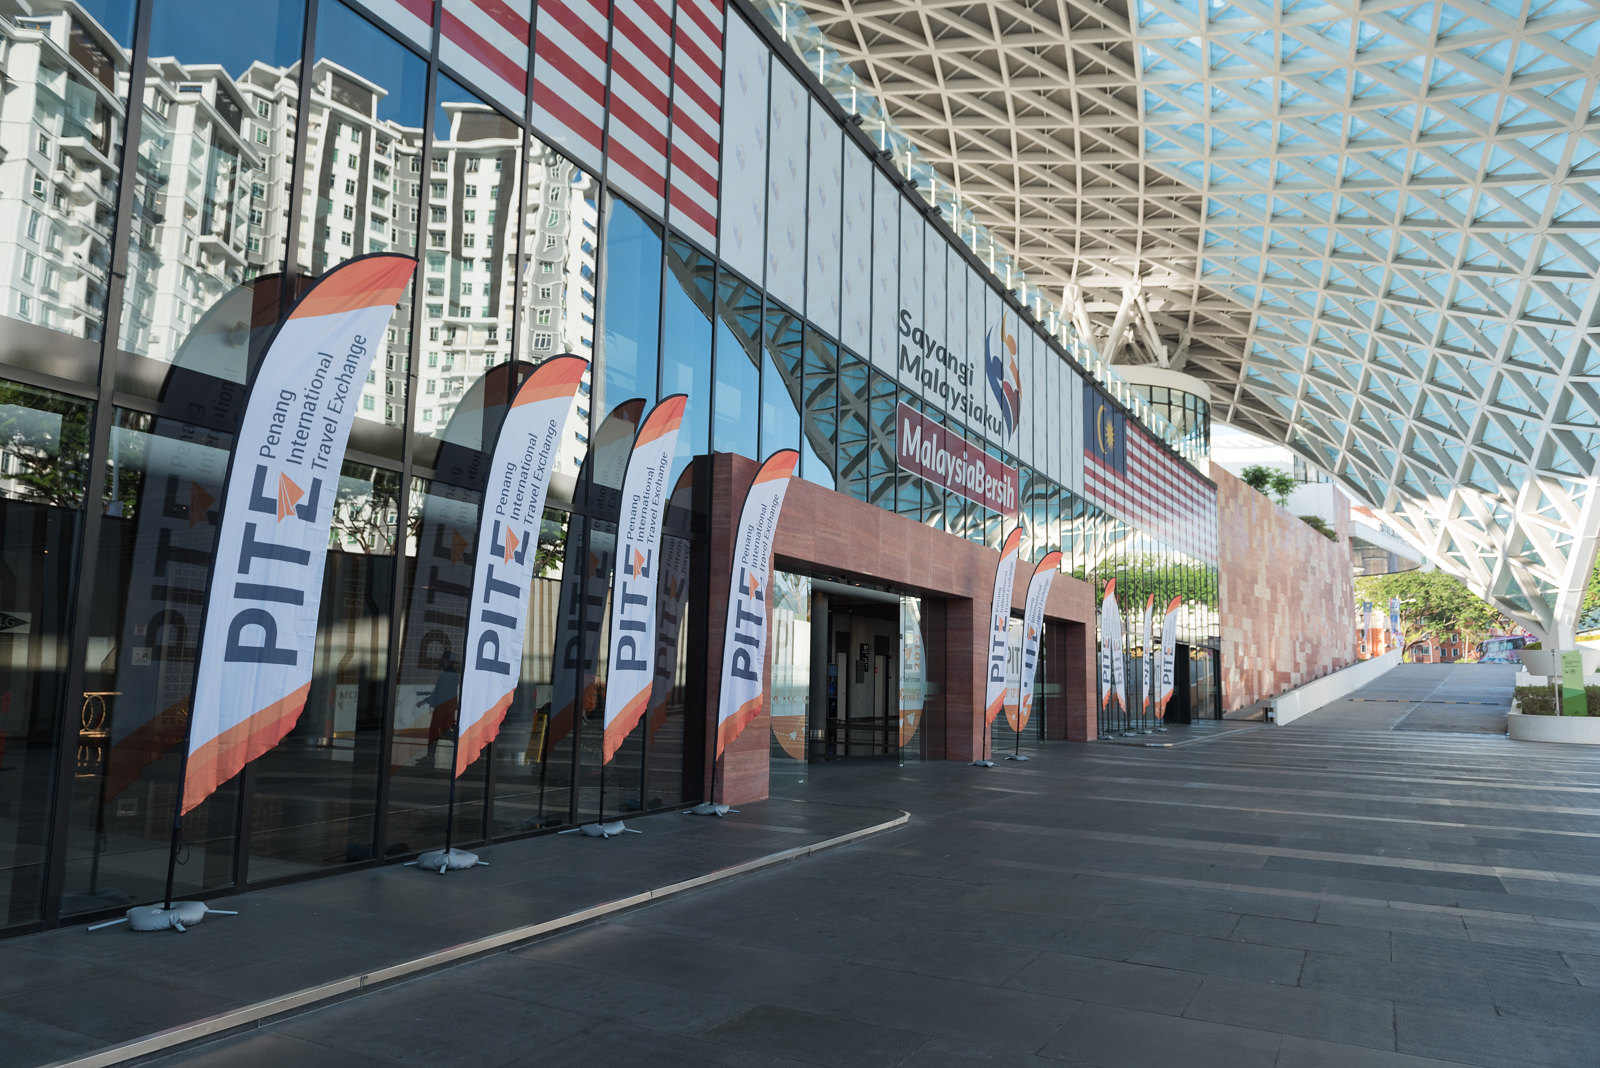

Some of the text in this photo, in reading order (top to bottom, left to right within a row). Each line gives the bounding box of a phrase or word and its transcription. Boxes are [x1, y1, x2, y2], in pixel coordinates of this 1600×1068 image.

[899, 309, 975, 387] Sayangi
[899, 343, 1003, 437] Malaysiaku
[259, 388, 298, 460] Penang
[285, 351, 335, 467] International
[311, 333, 368, 471] Travel Exchange
[495, 461, 517, 517] Penang
[509, 432, 538, 522] International
[523, 418, 558, 527] Travel Exchange
[636, 466, 656, 543] International
[646, 451, 669, 545] Travel Exchange
[902, 417, 1015, 510] MalaysiaBersih
[626, 494, 641, 540] Penang
[741, 523, 755, 566] Penang
[750, 503, 768, 570] International
[758, 493, 780, 575] Travel Exchange
[224, 463, 323, 667] PITE
[475, 519, 531, 676] PITE
[615, 543, 653, 671] PITE
[731, 567, 765, 683] PITE
[990, 614, 1007, 682] PITE
[1102, 636, 1110, 684] PITE
[1163, 646, 1173, 685] PITE
